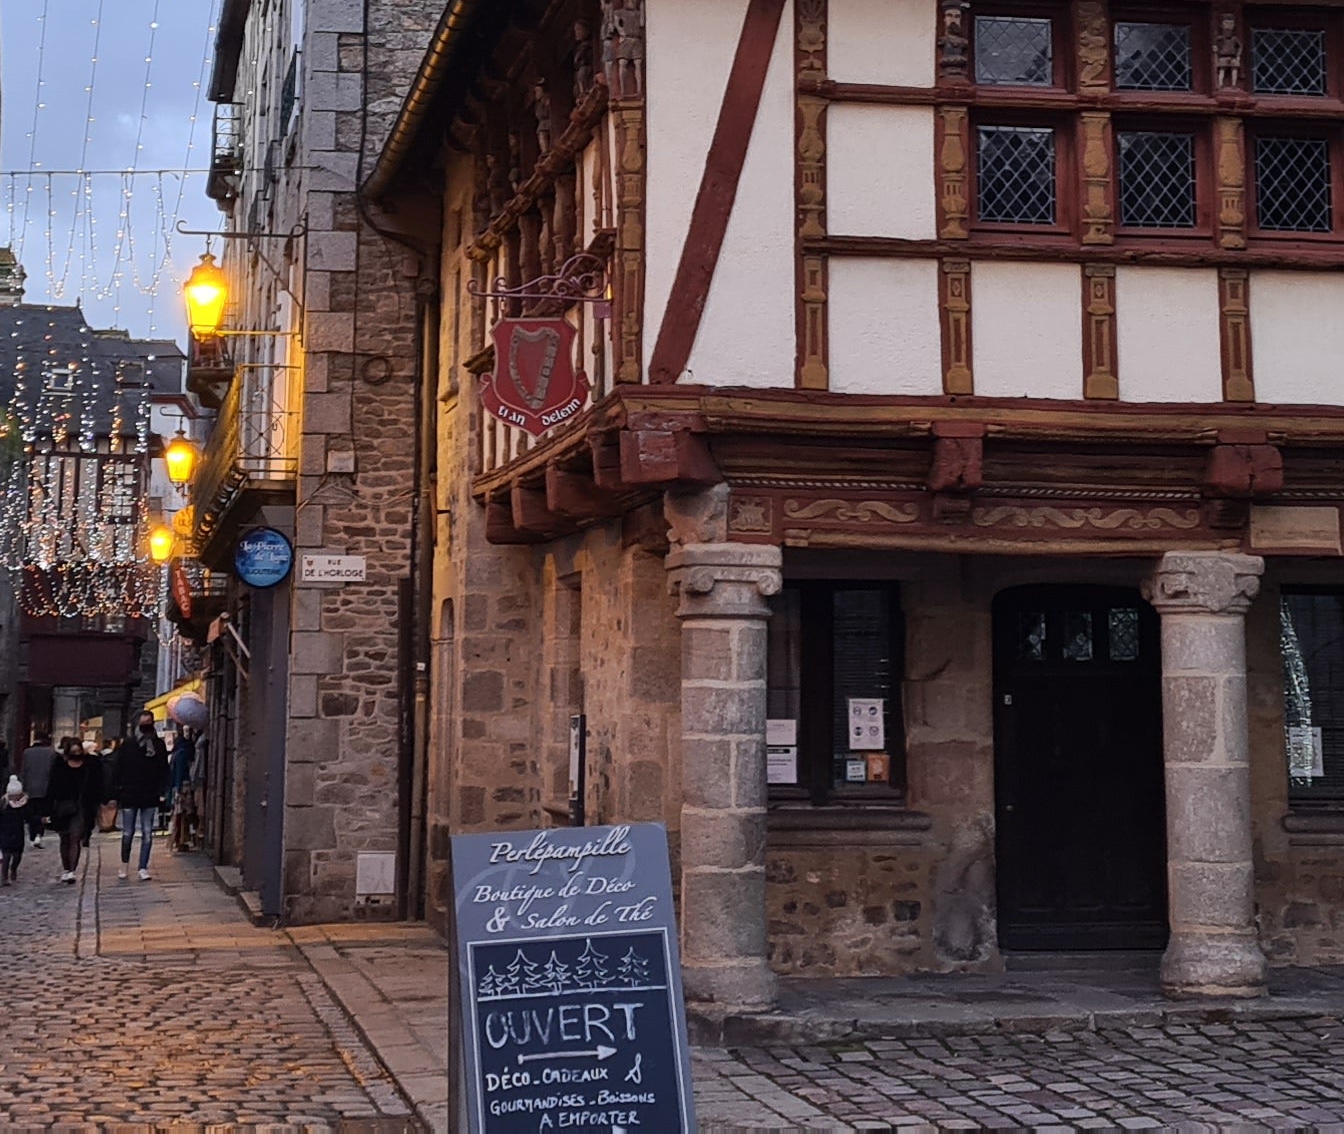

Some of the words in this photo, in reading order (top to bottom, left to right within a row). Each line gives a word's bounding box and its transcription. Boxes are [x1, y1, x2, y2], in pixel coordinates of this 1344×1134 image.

[305, 569, 315, 577] DE
[489, 825, 632, 875] Perlépampille
[473, 883, 555, 916] Boutique
[557, 871, 585, 898] de
[585, 877, 637, 896] Déco
[485, 906, 511, 933] &
[520, 904, 582, 930] Salon
[583, 901, 613, 926] de
[613, 896, 657, 923] Thé
[484, 1002, 645, 1050] OUVERT
[558, 1110, 641, 1128] EMPORTER
